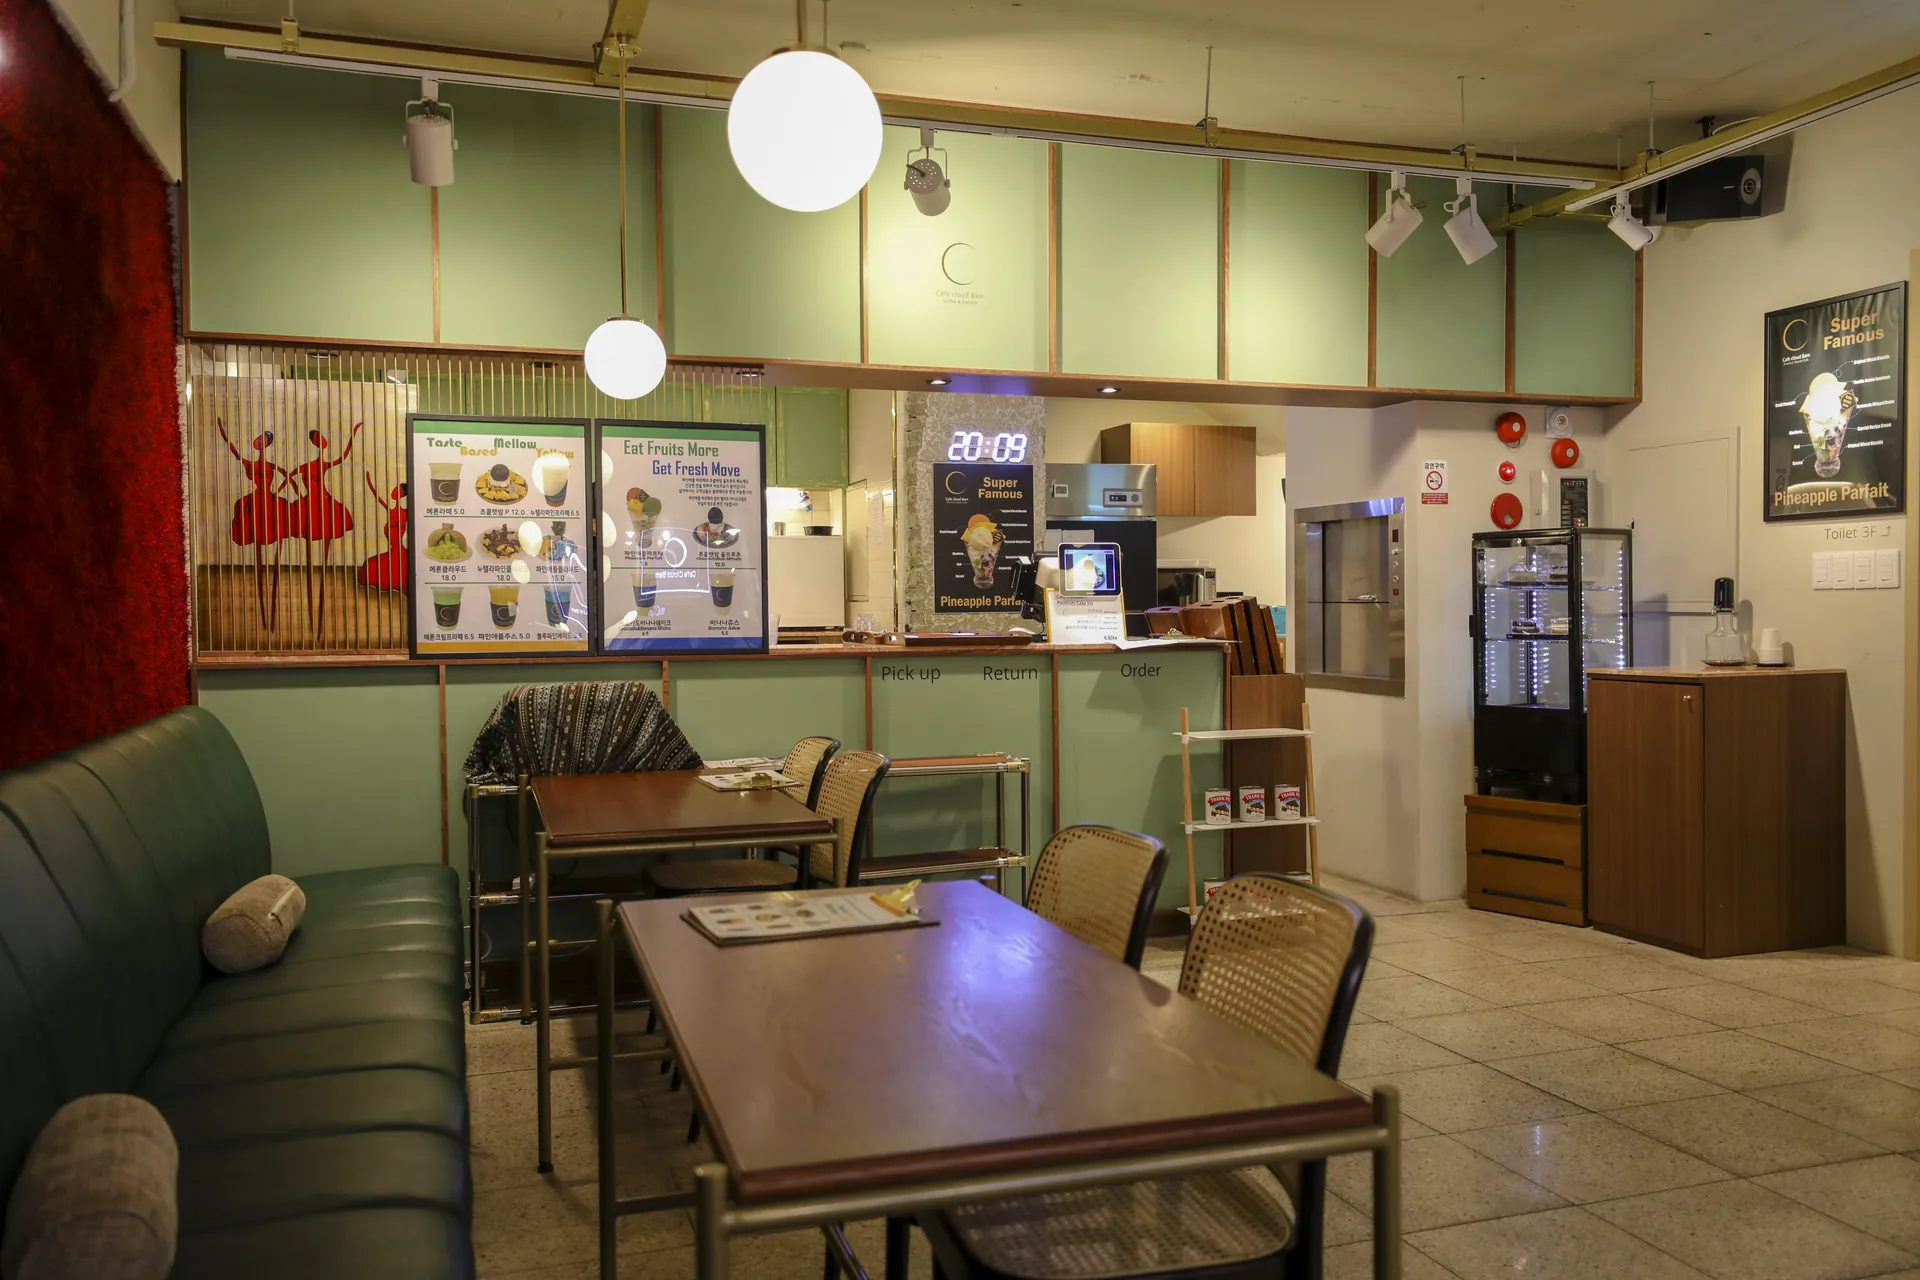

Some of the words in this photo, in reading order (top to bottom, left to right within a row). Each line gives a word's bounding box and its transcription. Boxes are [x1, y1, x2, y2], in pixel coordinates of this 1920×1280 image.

[1830, 313, 1878, 333] Super
[1823, 329, 1885, 350] Famous
[427, 437, 463, 448] Taste
[493, 438, 537, 449] Mellow
[624, 440, 643, 455] Eat
[647, 441, 684, 457] Fruits
[688, 442, 719, 457] More
[947, 431, 1027, 463] 20:09
[460, 446, 498, 456] Based
[652, 460, 672, 475] Get
[675, 461, 708, 476] Fresh
[711, 462, 740, 477] Move
[983, 477, 1018, 489] Super
[978, 489, 1023, 499] Famous
[1774, 488, 1838, 506] Pineapple
[1841, 482, 1889, 501] Parfait
[1824, 527, 1857, 540] Toilet
[1862, 526, 1877, 538] 3F
[429, 565, 467, 573] 메론클라우드
[940, 596, 991, 608] Pineapple
[994, 595, 1021, 606] Parfa
[881, 666, 914, 681] Pick
[919, 669, 941, 684] up
[984, 665, 1038, 681] Return
[1121, 663, 1161, 677] Order
